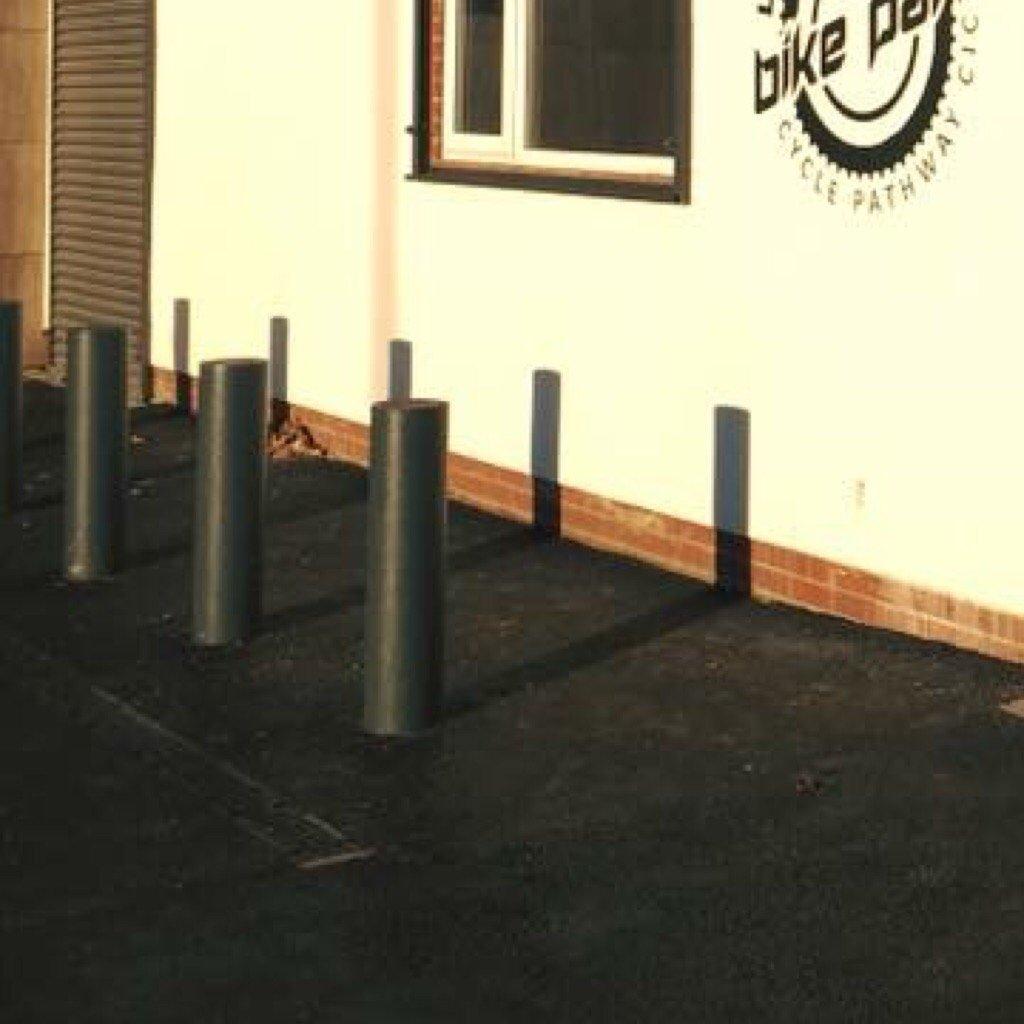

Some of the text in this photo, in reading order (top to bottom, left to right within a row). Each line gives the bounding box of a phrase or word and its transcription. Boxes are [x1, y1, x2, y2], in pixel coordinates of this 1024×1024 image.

[778, 14, 979, 214] CYCLE PATHWAY CIC
